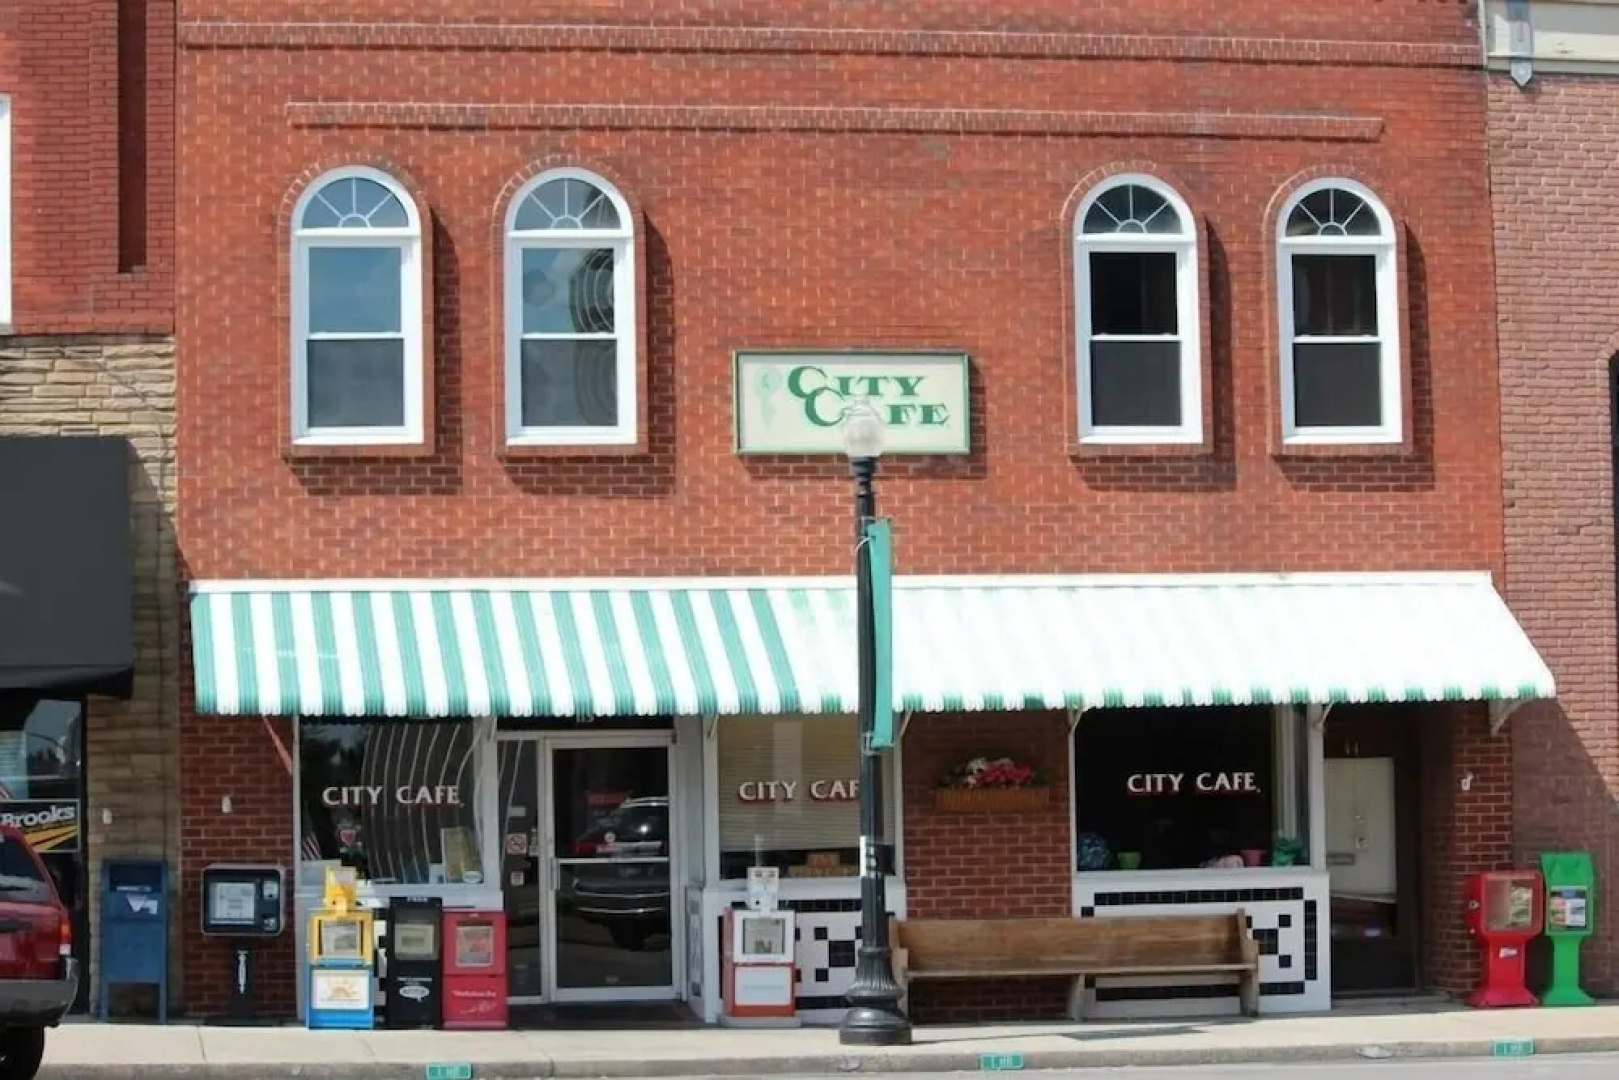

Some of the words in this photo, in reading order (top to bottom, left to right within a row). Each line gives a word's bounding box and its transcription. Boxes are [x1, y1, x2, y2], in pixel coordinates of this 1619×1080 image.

[788, 366, 927, 398] CITY
[805, 387, 950, 427] CFE
[739, 780, 797, 801] CITY
[810, 780, 860, 800] CAF
[1127, 772, 1184, 794] CITY
[322, 786, 382, 806] CITY
[0, 805, 75, 828] Brooks
